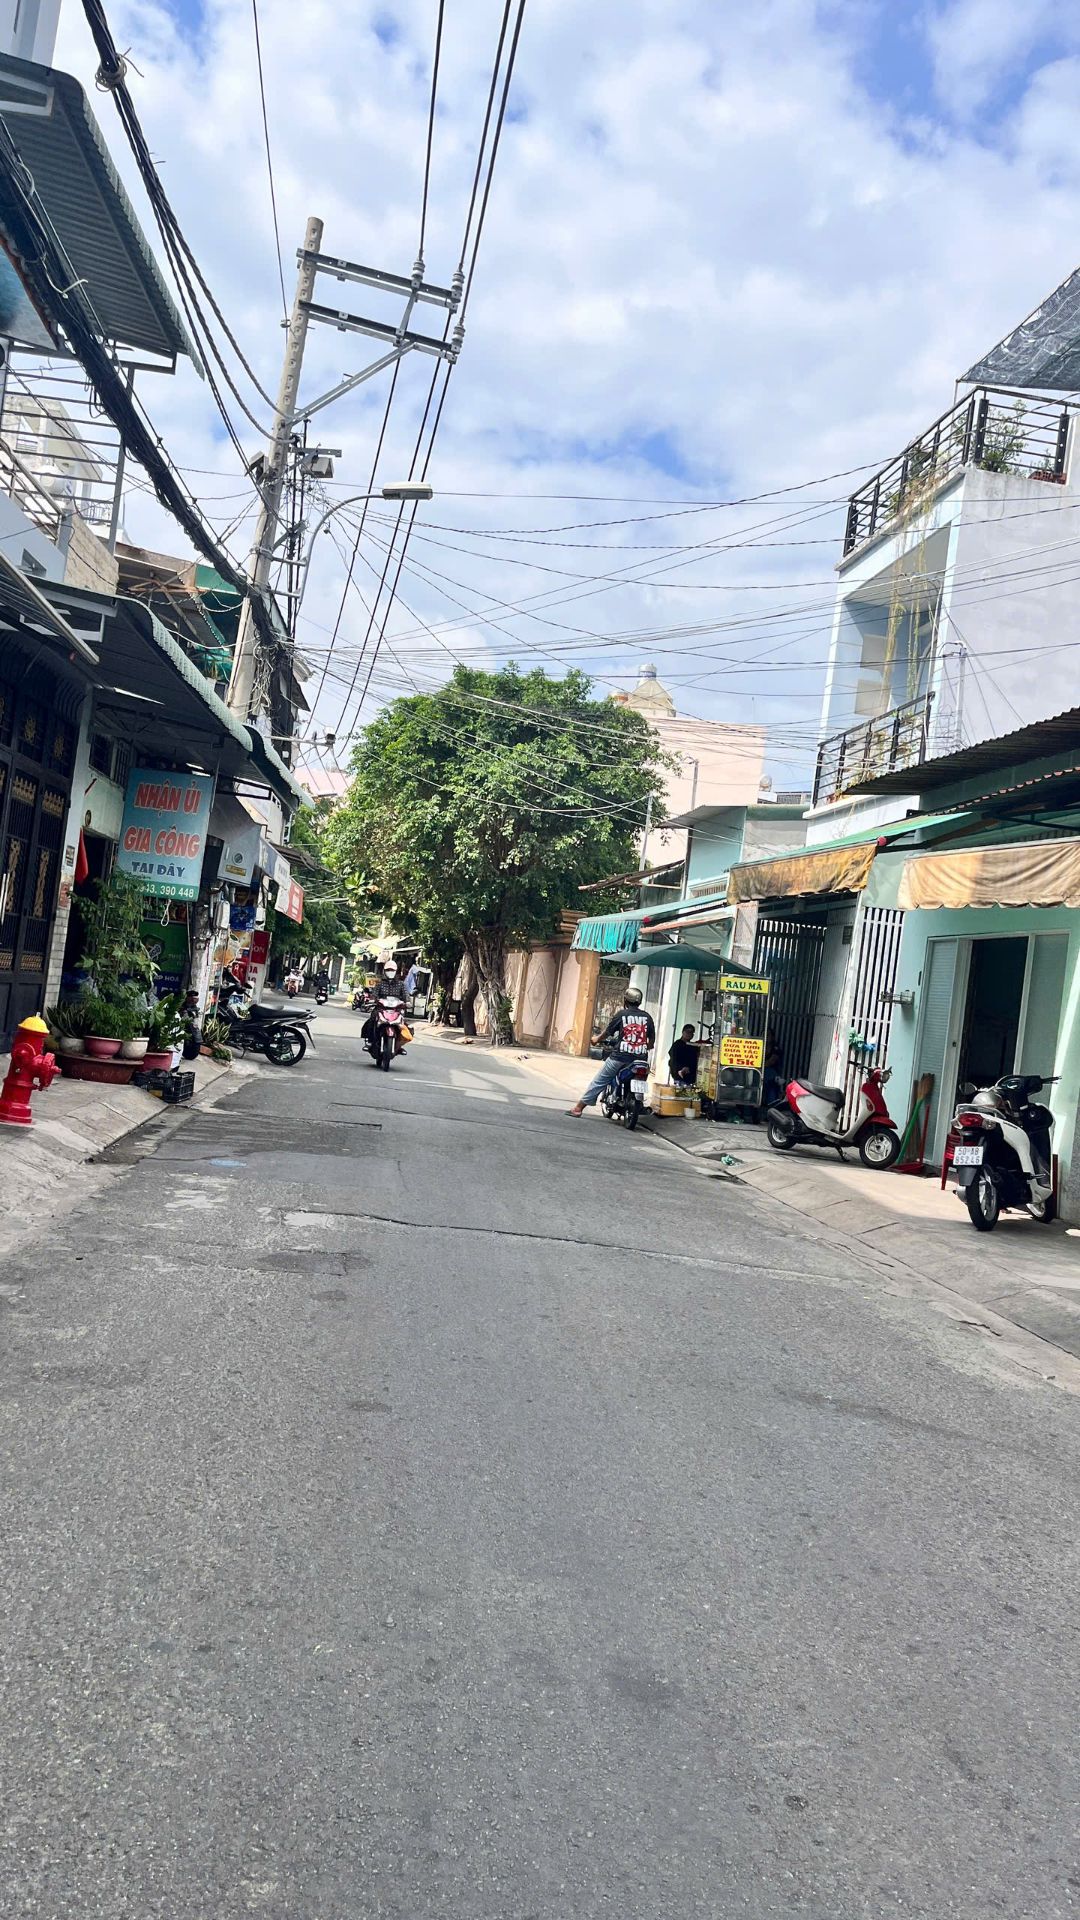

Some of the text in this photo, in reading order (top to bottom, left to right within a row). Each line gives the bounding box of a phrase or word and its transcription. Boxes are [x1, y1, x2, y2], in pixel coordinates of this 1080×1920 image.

[134, 780, 202, 818] NHẬN ỦI
[123, 823, 201, 860] GIA CÔNG
[157, 862, 185, 877] ĐÂY
[160, 885, 176, 896] 390
[178, 886, 194, 898] 448
[726, 981, 762, 990] RAU MÁ
[621, 1015, 648, 1030] LOVE
